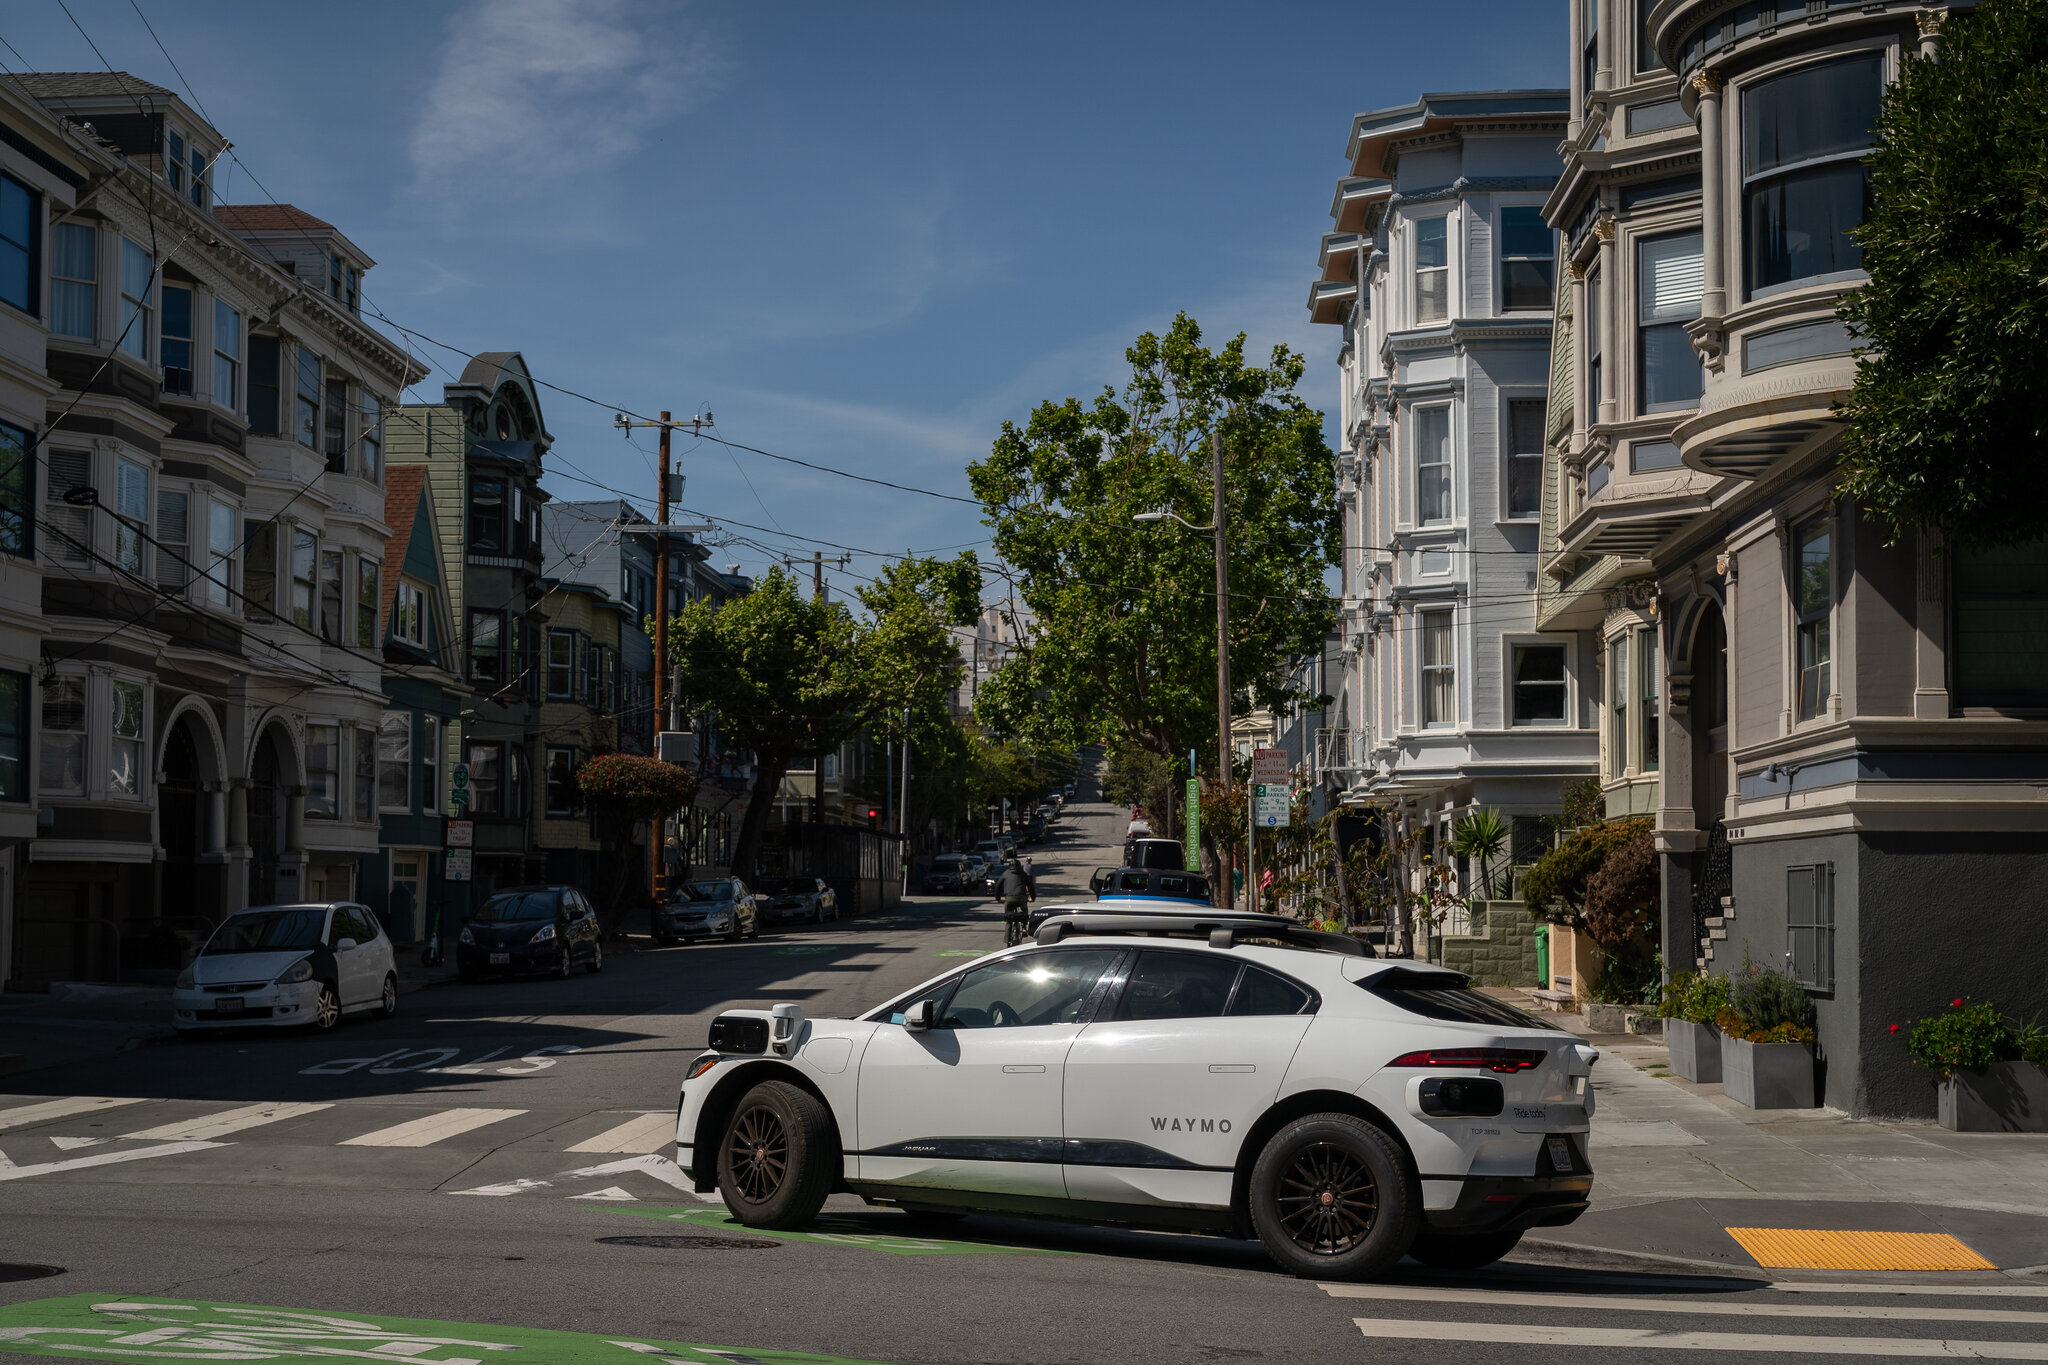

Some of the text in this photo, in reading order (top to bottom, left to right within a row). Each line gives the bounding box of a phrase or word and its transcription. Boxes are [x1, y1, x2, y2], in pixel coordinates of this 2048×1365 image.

[1255, 749, 1264, 759] NO
[1257, 786, 1264, 795] 2
[1188, 783, 1198, 867] eight watersheds
[448, 849, 454, 857] 2
[297, 1045, 583, 1075] STOP
[1514, 1107, 1547, 1121] Ride today
[1150, 1116, 1232, 1134] WAYMO
